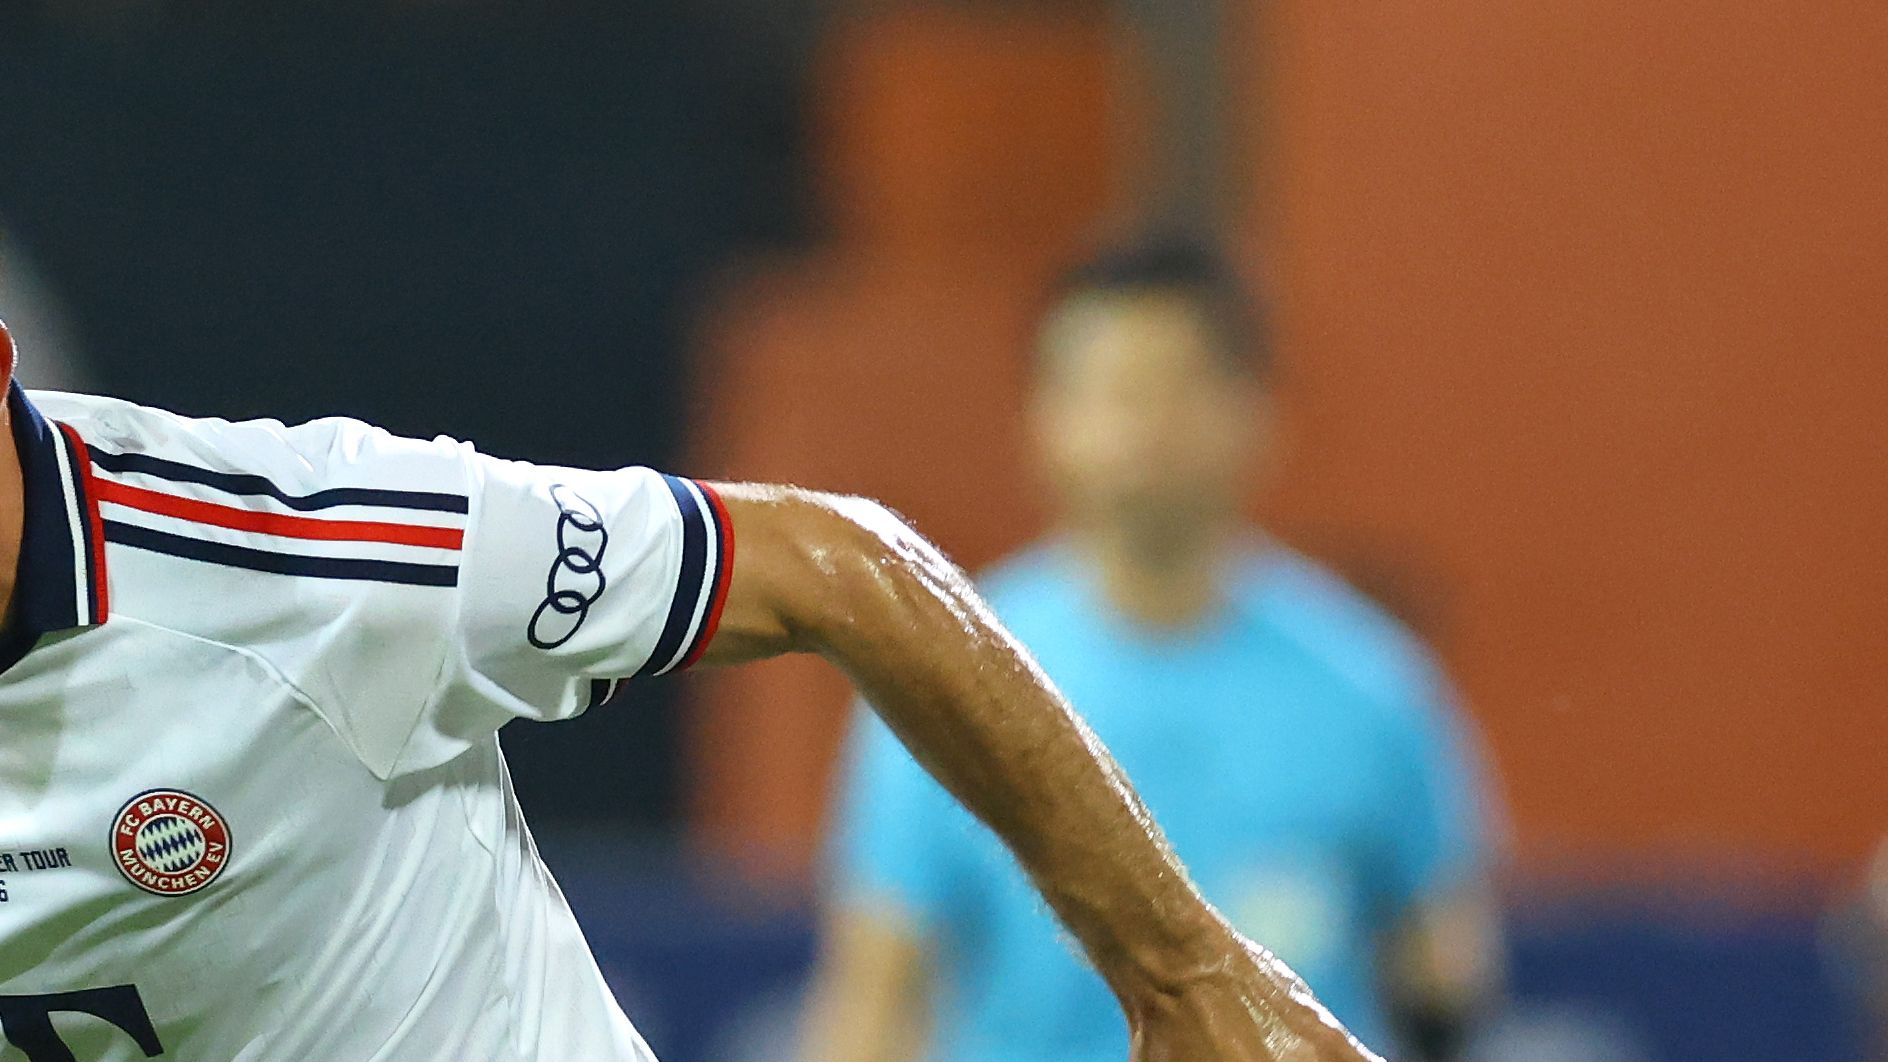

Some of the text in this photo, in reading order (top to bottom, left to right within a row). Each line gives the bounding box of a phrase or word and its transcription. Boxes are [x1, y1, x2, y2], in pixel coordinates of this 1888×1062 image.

[120, 797, 216, 836] FC BAYERN
[20, 847, 72, 871] TOUR
